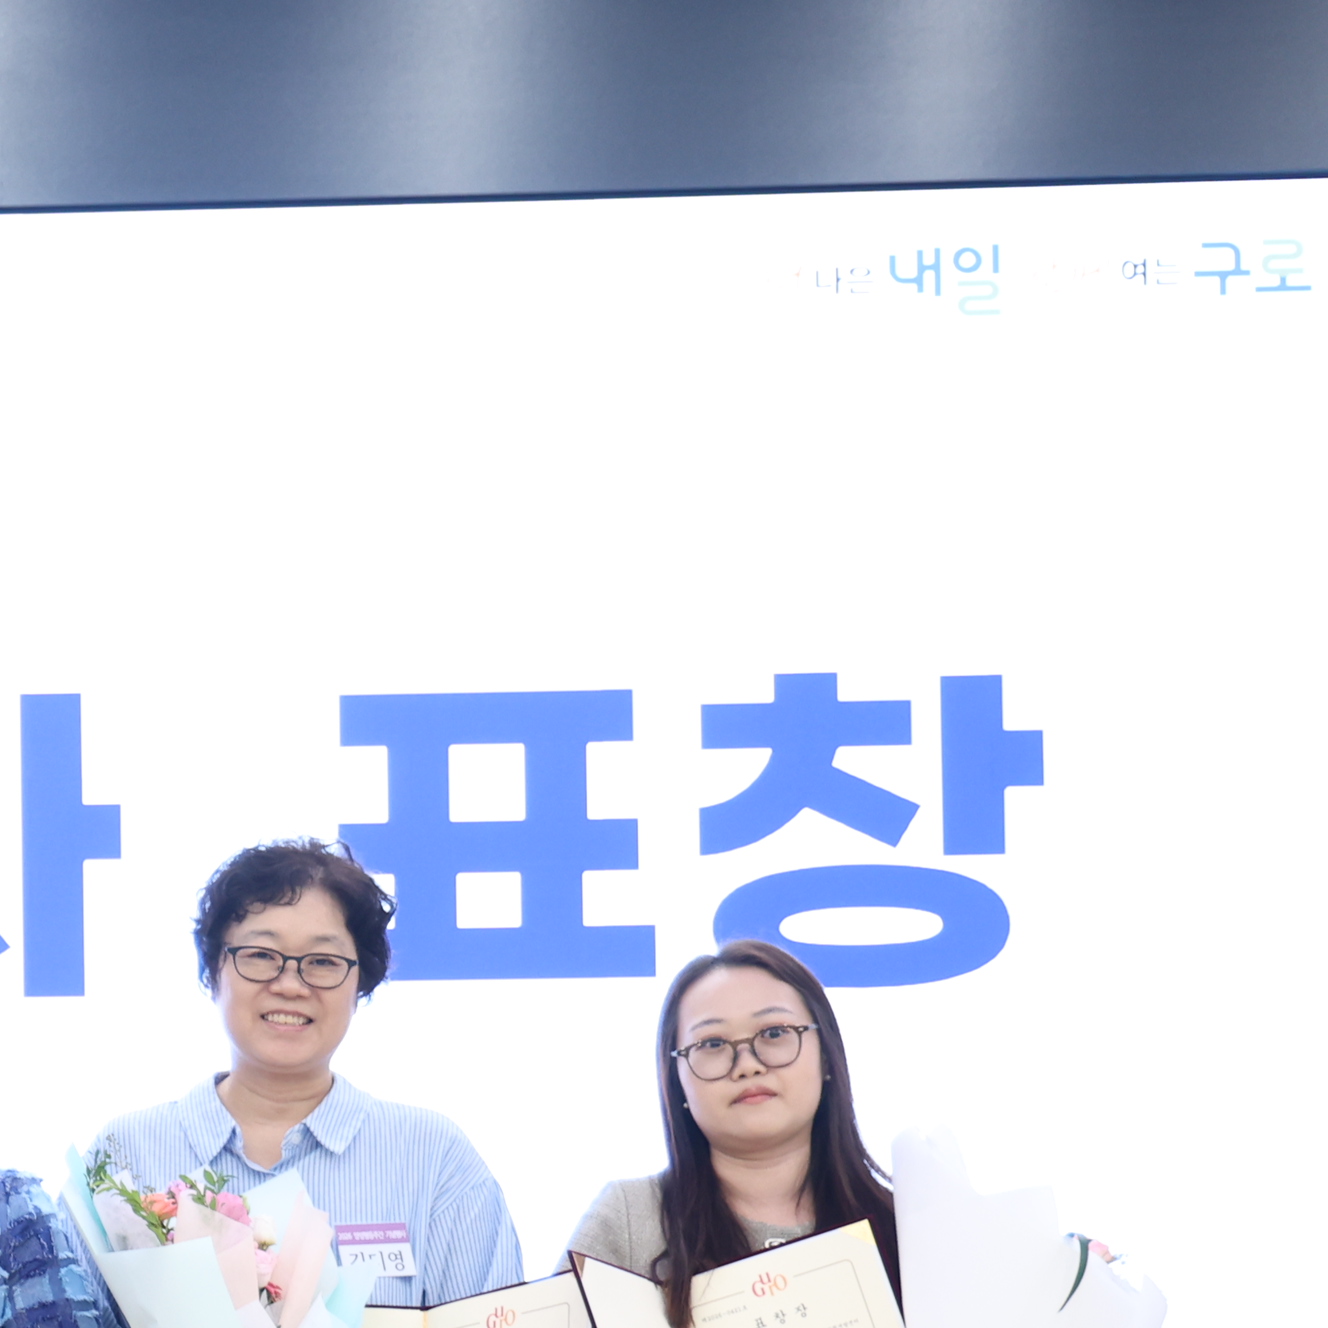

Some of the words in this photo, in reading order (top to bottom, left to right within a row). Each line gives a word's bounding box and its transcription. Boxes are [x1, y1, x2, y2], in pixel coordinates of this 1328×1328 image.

[889, 243, 1001, 316] 내일
[1193, 239, 1312, 296] 구로
[338, 672, 1044, 988] 표창
